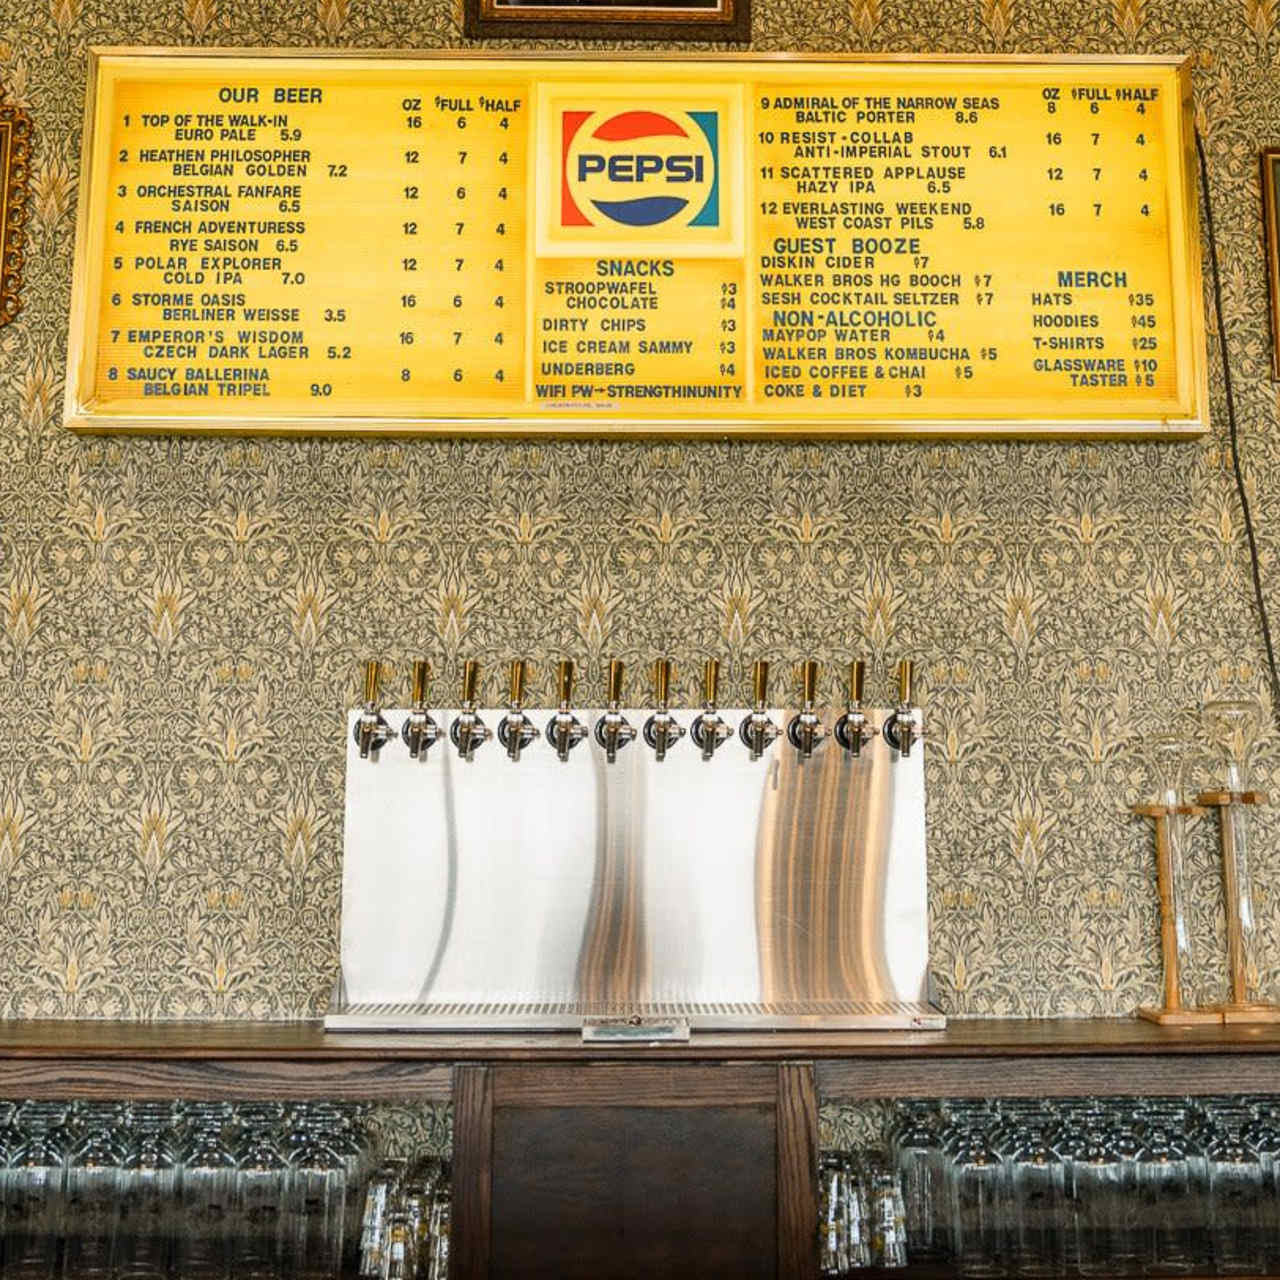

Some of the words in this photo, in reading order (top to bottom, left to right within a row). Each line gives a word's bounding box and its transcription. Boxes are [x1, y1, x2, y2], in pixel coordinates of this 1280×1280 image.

[218, 87, 259, 103] OUR
[273, 88, 323, 104] BEER
[1042, 88, 1061, 101] OZ
[402, 98, 421, 112] OZ
[761, 97, 770, 110] 9
[773, 97, 839, 110] ADMIRAL
[841, 97, 860, 109] OF
[864, 97, 891, 110] THE
[896, 97, 957, 110] NARROW
[963, 97, 1000, 110] SEAS
[1047, 101, 1056, 114] 8
[1090, 101, 1100, 114] 6
[123, 114, 130, 128] 1
[141, 114, 170, 128] TOP
[174, 114, 192, 127] OF
[196, 114, 224, 127] THE
[228, 114, 288, 128] WALK-IN
[407, 116, 422, 128] 16
[457, 116, 466, 129] 6
[795, 111, 847, 124] BALTIC
[856, 110, 915, 124] PORTER
[955, 111, 978, 124] 8.6
[175, 128, 214, 141] EURO
[220, 128, 256, 141] PALE
[280, 128, 302, 141] 5.9
[758, 131, 774, 144] 10
[1046, 132, 1062, 145] 16
[1091, 133, 1100, 145] 7
[118, 149, 128, 163] 2
[139, 149, 205, 163] HEATHEN
[211, 149, 311, 163] PHILOSOPHER
[405, 151, 419, 164] 12
[458, 151, 467, 164] 7
[921, 145, 971, 158] STOUT
[989, 146, 1007, 158] 6.1
[173, 163, 234, 177] BELGIAN
[245, 163, 307, 177] GOLDEN
[328, 164, 348, 178] 7.2
[578, 154, 704, 183] PEPSI
[760, 166, 773, 179] 11
[780, 166, 874, 179] SCATTERED
[883, 166, 966, 180] APPLAUSE
[1047, 168, 1063, 180] 12
[1092, 168, 1101, 181] 7
[117, 185, 127, 198] 3
[136, 184, 232, 198] ORCHESTRAL
[237, 185, 301, 198] FANFARE
[404, 186, 419, 199] 12
[456, 187, 466, 200] 6
[797, 181, 838, 194] HAZY
[849, 181, 876, 193] IPA
[927, 180, 951, 194] 6.5
[171, 200, 229, 212] SAISON
[279, 200, 301, 213] 6.5
[760, 201, 778, 215] 12
[783, 202, 885, 216] EVERLASTING
[896, 202, 972, 215] WEEKEND
[1049, 203, 1065, 216] 16
[1093, 203, 1102, 216] 7
[115, 220, 124, 234] 4
[135, 220, 192, 234] FRENCH
[197, 220, 306, 234] ADVENTURESS
[403, 222, 418, 235] 12
[455, 222, 464, 235] 7
[795, 216, 836, 230] WEST
[842, 216, 892, 230] COAST
[901, 216, 934, 230] PILS
[963, 217, 985, 230] 5.8
[169, 238, 198, 252] RYE
[204, 239, 259, 252] SAISON
[276, 239, 298, 253] 6.5
[773, 237, 836, 254] GUEST
[852, 237, 920, 255] BOOZE
[113, 256, 123, 270] 5
[135, 256, 187, 270] POLAR
[201, 256, 281, 270] EXPLORER
[402, 258, 417, 271] 12
[455, 259, 464, 271] 7
[596, 259, 674, 277] SNACKS
[761, 256, 815, 269] DISKIN
[825, 256, 874, 269] CIDER
[163, 273, 205, 284] COLD
[216, 271, 242, 285] IPA
[282, 272, 305, 285] 7.0
[760, 273, 824, 287] WALKER
[832, 274, 873, 287] BROS
[880, 274, 901, 287] HG
[909, 274, 961, 288] BOOCH
[1057, 271, 1127, 288] MERCH
[545, 281, 656, 295] STROOPWAFEL
[111, 293, 122, 306] 6
[132, 293, 193, 307] STORME
[200, 293, 245, 307] OASIS
[401, 294, 416, 308] 16
[453, 295, 462, 308] 6
[566, 296, 658, 309] CHOCOLATE
[762, 292, 801, 305] SESH
[810, 292, 888, 305] COCKTAIL
[893, 292, 959, 305] SELTZER
[1032, 292, 1072, 306] HATS
[162, 308, 235, 321] BERLINER
[243, 308, 300, 322] WEISSE
[324, 308, 346, 322] 3.5
[1033, 314, 1099, 328] HOODIES
[542, 318, 588, 332] DIRTY
[600, 318, 646, 332] CHIPS
[111, 330, 120, 343] 7
[128, 330, 224, 344] EMPEROR'S
[237, 330, 304, 344] WISDOM
[400, 332, 414, 345] 16
[453, 332, 462, 345] 7
[762, 328, 827, 342] MAYPOP
[834, 328, 890, 342] WATER
[543, 340, 568, 354] ICE
[576, 340, 630, 354] CREAM
[638, 340, 693, 354] SAMMY
[1032, 336, 1104, 350] T-SHIRTS
[142, 344, 197, 359] CZECH
[208, 345, 249, 359] DARK
[258, 345, 309, 359] LAGER
[328, 346, 351, 359] 5.2
[763, 347, 827, 360] WALKER
[835, 347, 877, 360] BROS
[884, 347, 970, 360] KOMBUCHA
[541, 362, 635, 376] UNDERBERG
[765, 365, 802, 379] ICED
[809, 365, 868, 379] COFFEE
[874, 365, 885, 379] &
[888, 366, 925, 379] CHAI
[1033, 358, 1125, 372] GLASSWARE
[107, 367, 118, 381] 8
[126, 367, 178, 381] SAUCY
[185, 367, 270, 381] BALLERINA
[401, 368, 410, 382] 8
[453, 368, 463, 382] 6
[1069, 373, 1128, 387] TASTER
[143, 383, 208, 398] BELGIAN
[217, 383, 270, 396] TRIPEL
[310, 384, 332, 397] 9.0
[536, 384, 566, 398] WIFI
[764, 384, 805, 398] COKE
[812, 384, 822, 398] &
[829, 384, 867, 398] DIET
